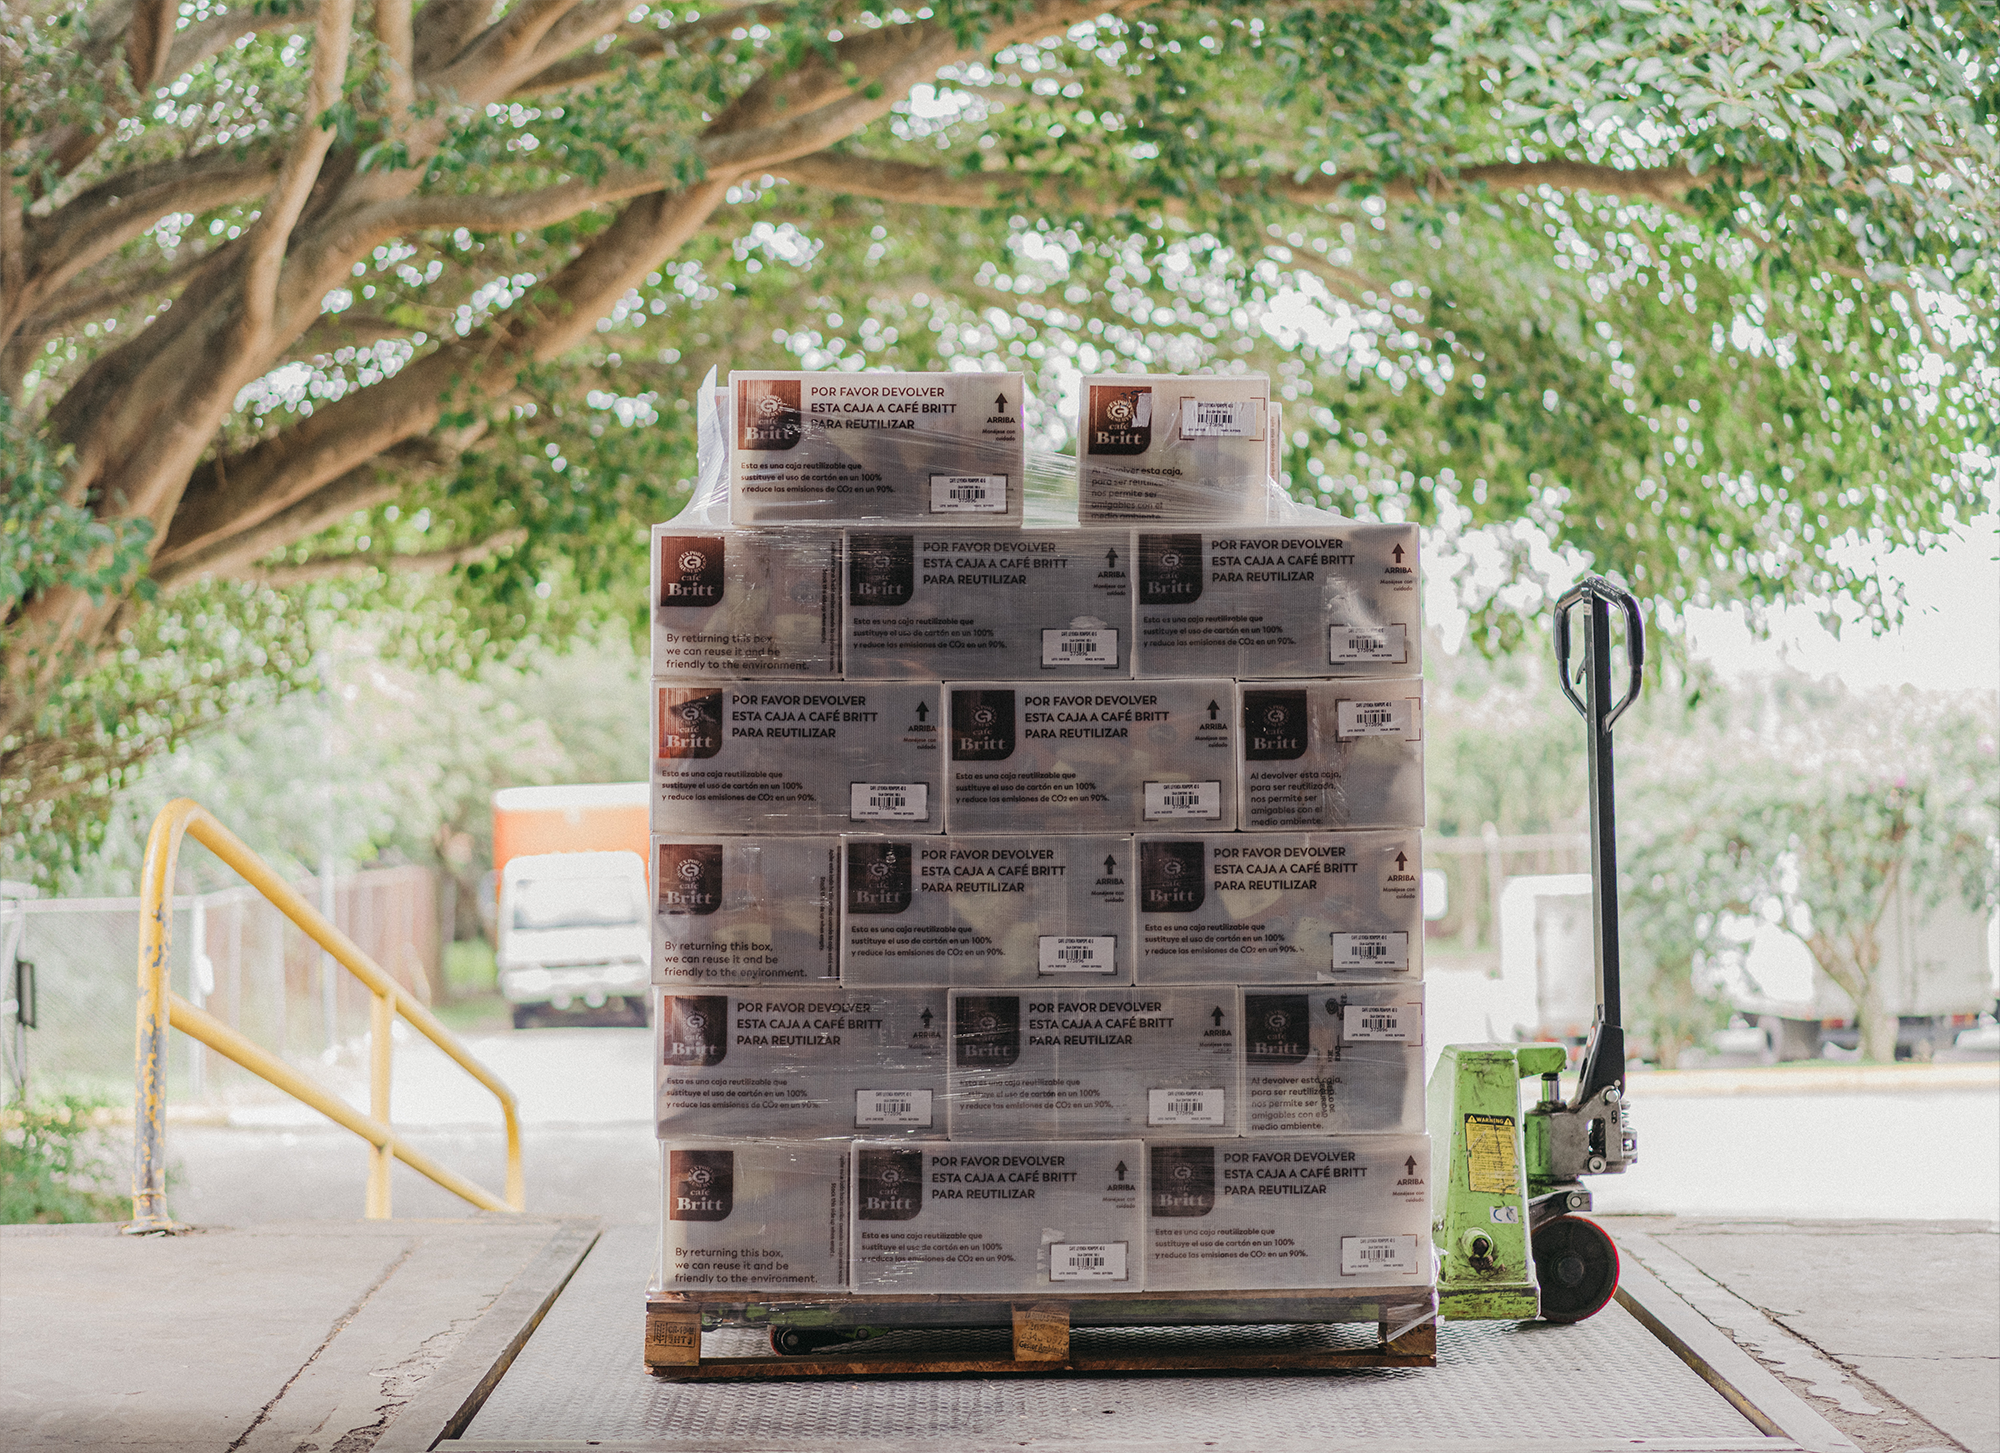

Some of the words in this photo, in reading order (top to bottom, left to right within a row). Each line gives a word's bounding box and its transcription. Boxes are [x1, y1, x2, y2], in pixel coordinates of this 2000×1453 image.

[811, 387, 836, 396] POR
[840, 387, 878, 396] FAVOR
[882, 387, 944, 396] DEVOLVER
[811, 403, 840, 413] ESTA
[844, 403, 873, 412] CAJA
[877, 404, 884, 412] A
[888, 402, 918, 413] CAFÉ
[922, 404, 956, 413] BRITT
[845, 419, 914, 429] REUTILIZAR
[1096, 431, 1142, 445] Britt
[1212, 540, 1237, 550] POR
[1240, 540, 1278, 549] FAVOR
[1281, 539, 1343, 549] DEVOLVER
[1212, 556, 1240, 566] ESTA
[1244, 556, 1274, 565] CAJA
[1277, 557, 1284, 565] A
[1288, 554, 1318, 565] CAFÉ
[1321, 555, 1354, 565] BRITT
[1212, 572, 1243, 582] PARA
[1246, 571, 1314, 581] REUTILIZAR
[668, 583, 714, 596] Britt
[732, 695, 758, 704] POR
[761, 695, 800, 705] FAVOR
[803, 696, 866, 705] DEVOLVER
[732, 711, 761, 721] ESTA
[765, 712, 795, 721] CAJA
[798, 713, 805, 721] A
[809, 710, 839, 721] CAFÉ
[843, 712, 876, 722] BRITT
[732, 728, 763, 737] PARA
[767, 728, 836, 738] REUTILIZAR
[667, 734, 713, 748] Britt
[960, 737, 1006, 750] Britt
[1254, 736, 1298, 750] Britt
[1268, 795, 1302, 803] permite
[1251, 806, 1295, 815] amigables
[922, 850, 946, 859] POR
[950, 850, 989, 860] FAVOR
[992, 850, 1053, 859] DEVOLVER
[922, 867, 950, 876] ESTA
[954, 866, 983, 876] CAJA
[988, 867, 994, 875] A
[998, 864, 1028, 876] CAFÉ
[1032, 866, 1064, 875] BRITT
[922, 883, 952, 892] PARA
[956, 883, 1024, 892] REUTILIZAR
[667, 890, 712, 904] Britt
[1150, 888, 1195, 902] Britt
[1029, 1003, 1054, 1013] POR
[1058, 1003, 1096, 1012] FAVOR
[1099, 1002, 1161, 1012] DEVOLVER
[1030, 1019, 1058, 1029] ESTA
[1062, 1020, 1092, 1029] CAJA
[1095, 1020, 1102, 1028] A
[1106, 1018, 1136, 1028] CAFÉ
[1139, 1018, 1173, 1028] BRITT
[1030, 1036, 1060, 1045] PARA
[1064, 1035, 1132, 1045] REUTILIZAR
[1255, 1041, 1299, 1055] Britt
[1476, 1116, 1504, 1125] WARNING
[932, 1157, 957, 1166] POR
[960, 1156, 999, 1166] FAVOR
[1002, 1156, 1065, 1166] DEVOLVER
[1224, 1153, 1249, 1162] POR
[1252, 1152, 1291, 1162] FAVOR
[1294, 1152, 1355, 1162] DEVOLVER
[932, 1173, 961, 1182] ESTA
[965, 1173, 994, 1182] CAJA
[998, 1174, 1005, 1182] A
[1009, 1170, 1039, 1182] CAFÉ
[1042, 1172, 1076, 1182] BRITT
[1225, 1169, 1253, 1179] ESTA
[1257, 1169, 1286, 1178] CAJA
[1289, 1170, 1297, 1178] A
[1300, 1166, 1330, 1178] CAFÉ
[1333, 1167, 1367, 1177] BRITT
[932, 1189, 963, 1199] PARA
[966, 1189, 1035, 1199] REUTILIZAR
[1225, 1186, 1255, 1195] PARA
[1259, 1185, 1326, 1195] REUTILIZAR
[677, 1197, 723, 1210] Britt
[867, 1196, 912, 1209] Britt
[676, 1248, 688, 1258] By
[691, 1248, 738, 1259] returning
[741, 1248, 759, 1257] this
[743, 1261, 751, 1269] it
[754, 1261, 773, 1270] and
[776, 1261, 789, 1270] be
[675, 1274, 714, 1284] friendly
